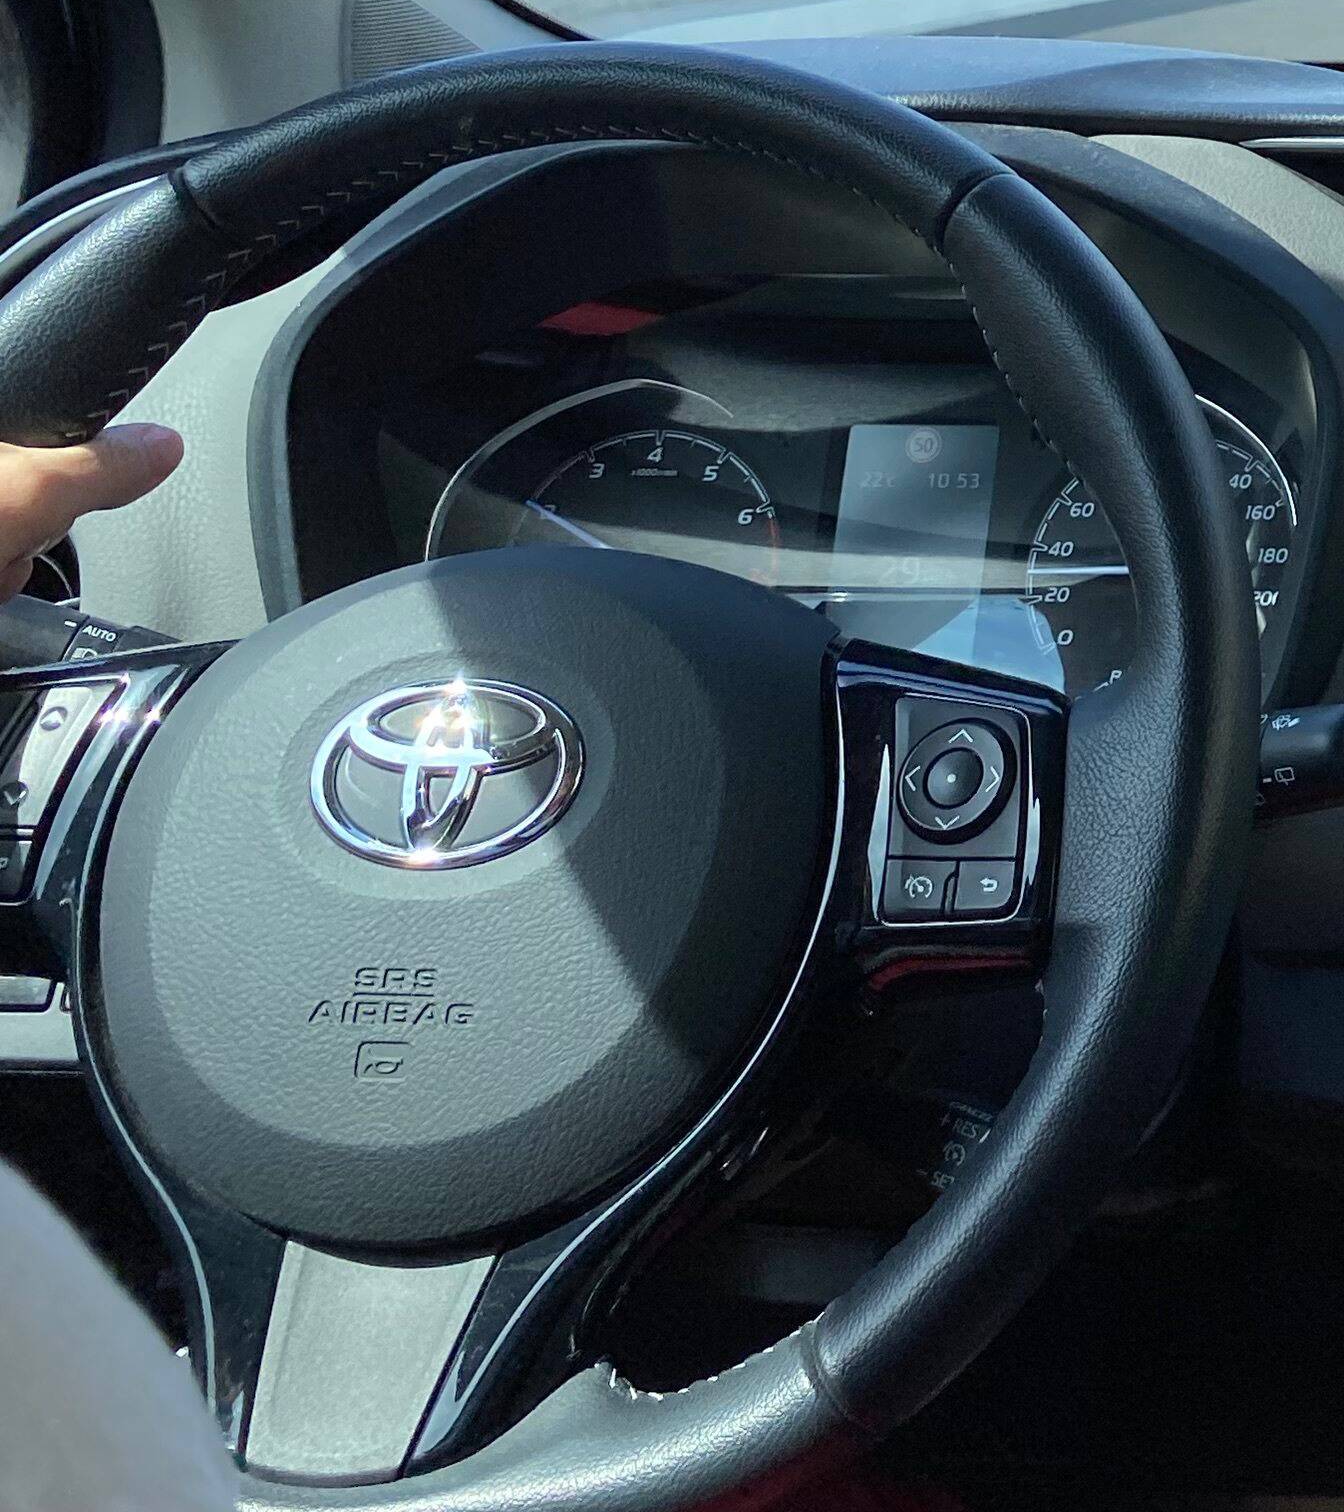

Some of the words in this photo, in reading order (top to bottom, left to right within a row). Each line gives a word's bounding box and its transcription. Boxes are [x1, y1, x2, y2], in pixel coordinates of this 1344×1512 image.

[914, 437, 933, 453] 50
[646, 447, 664, 463] 4
[588, 463, 606, 479] 3
[702, 465, 720, 482] 5
[737, 508, 755, 526] 6
[1069, 502, 1095, 518] 60
[1245, 504, 1276, 521] 160
[1047, 541, 1074, 557] 40
[1257, 548, 1289, 564] 180
[1044, 587, 1071, 603] 20
[82, 624, 117, 643] AUTO
[1057, 629, 1074, 646] 0
[354, 967, 437, 989] SRS
[308, 999, 474, 1025] AIRBAG
